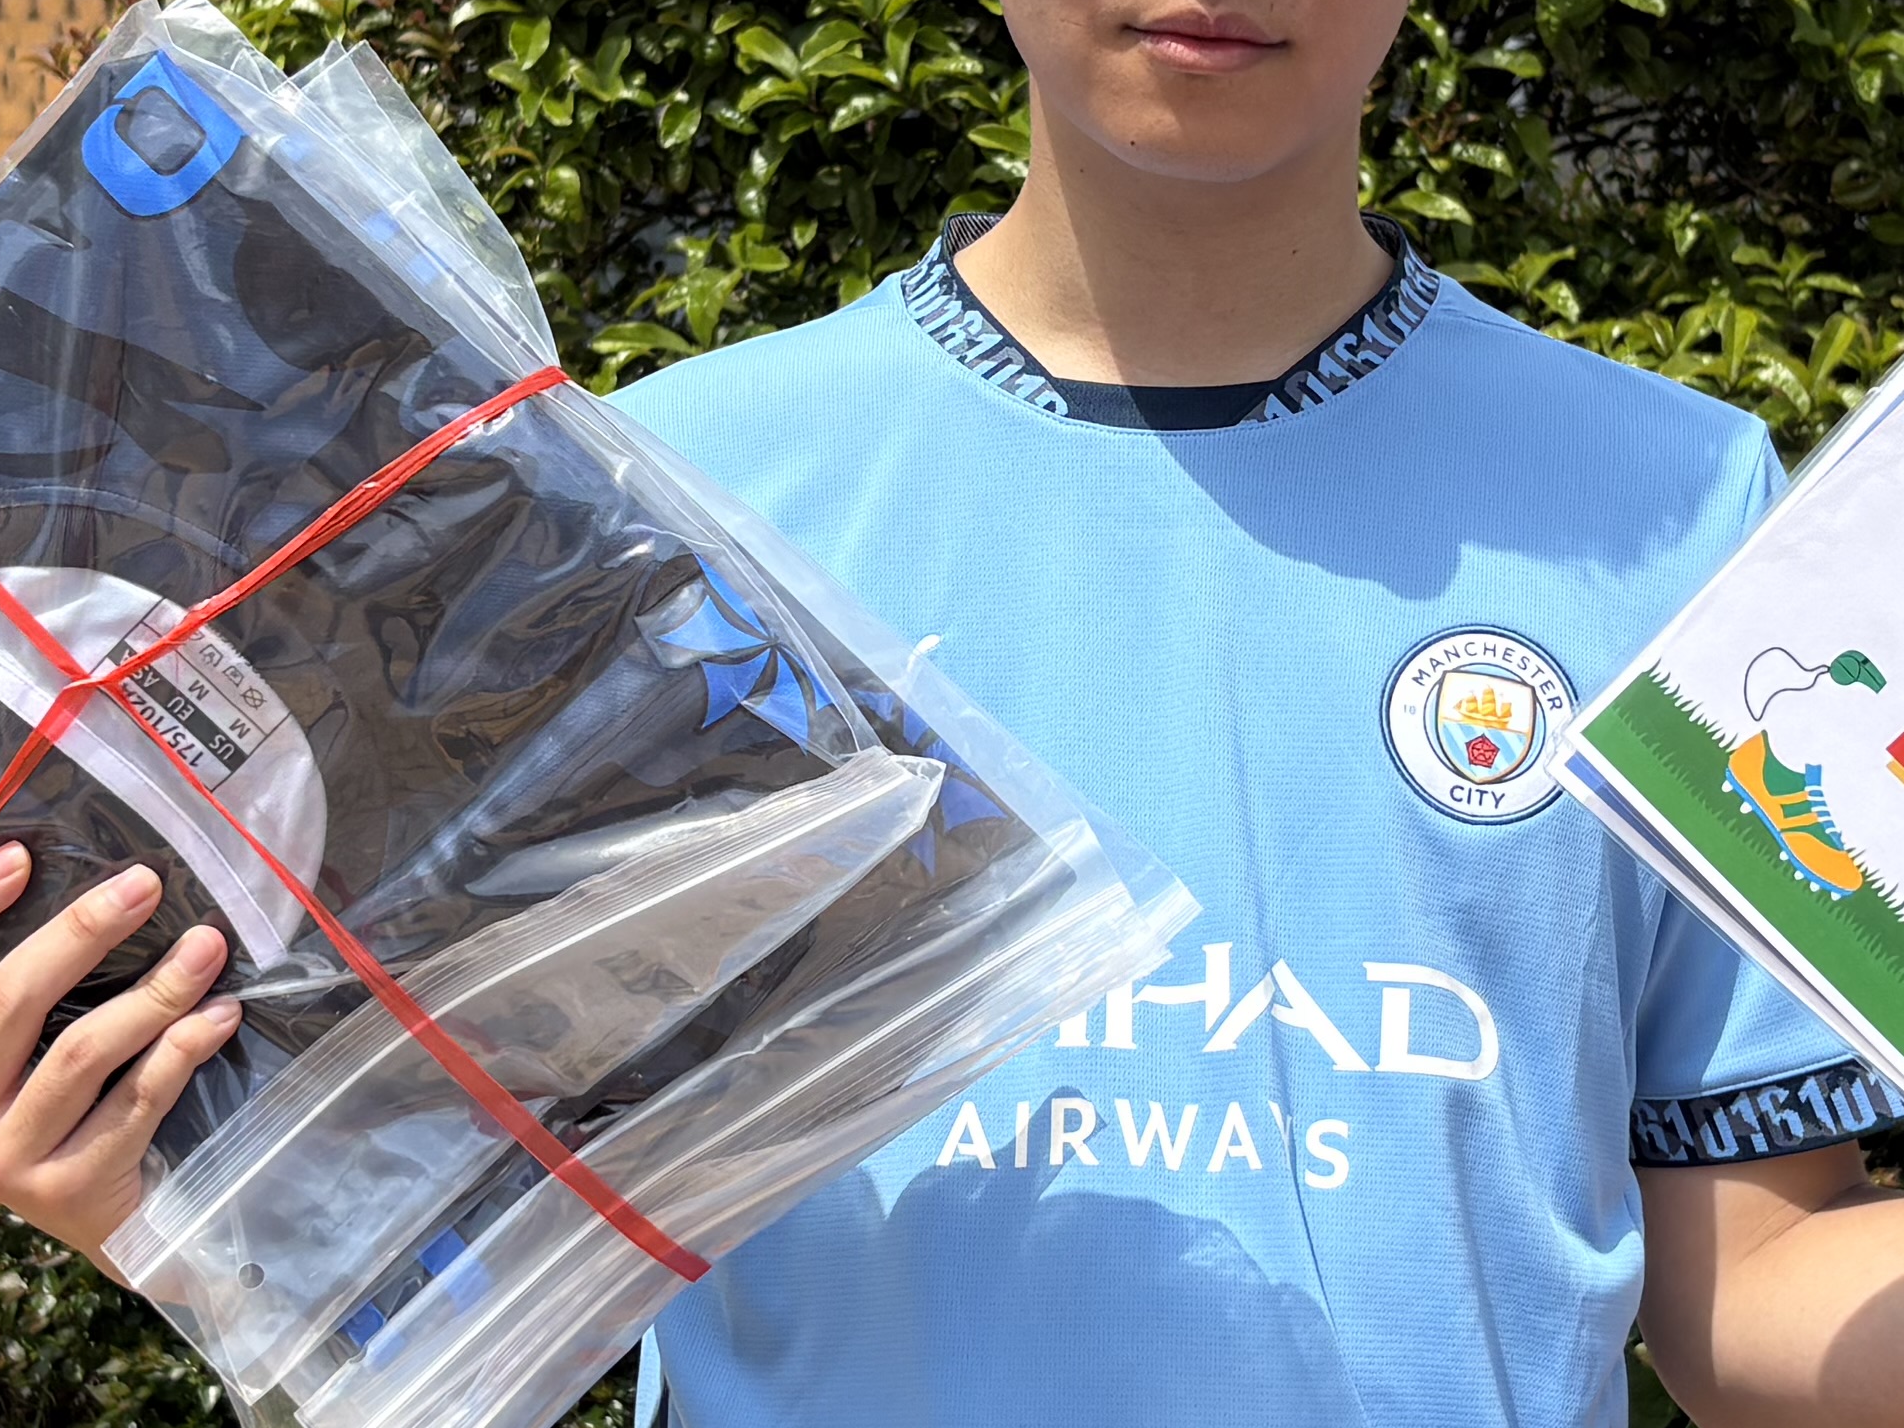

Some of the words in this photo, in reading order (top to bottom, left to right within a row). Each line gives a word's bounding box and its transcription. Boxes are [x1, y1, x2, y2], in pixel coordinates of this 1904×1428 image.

[119, 648, 160, 688] ASA
[1411, 641, 1564, 712] MANCHESTER
[187, 678, 210, 702] M
[165, 695, 196, 722] EU
[228, 717, 251, 740] M
[208, 733, 236, 761] US
[1449, 784, 1506, 809] CITY
